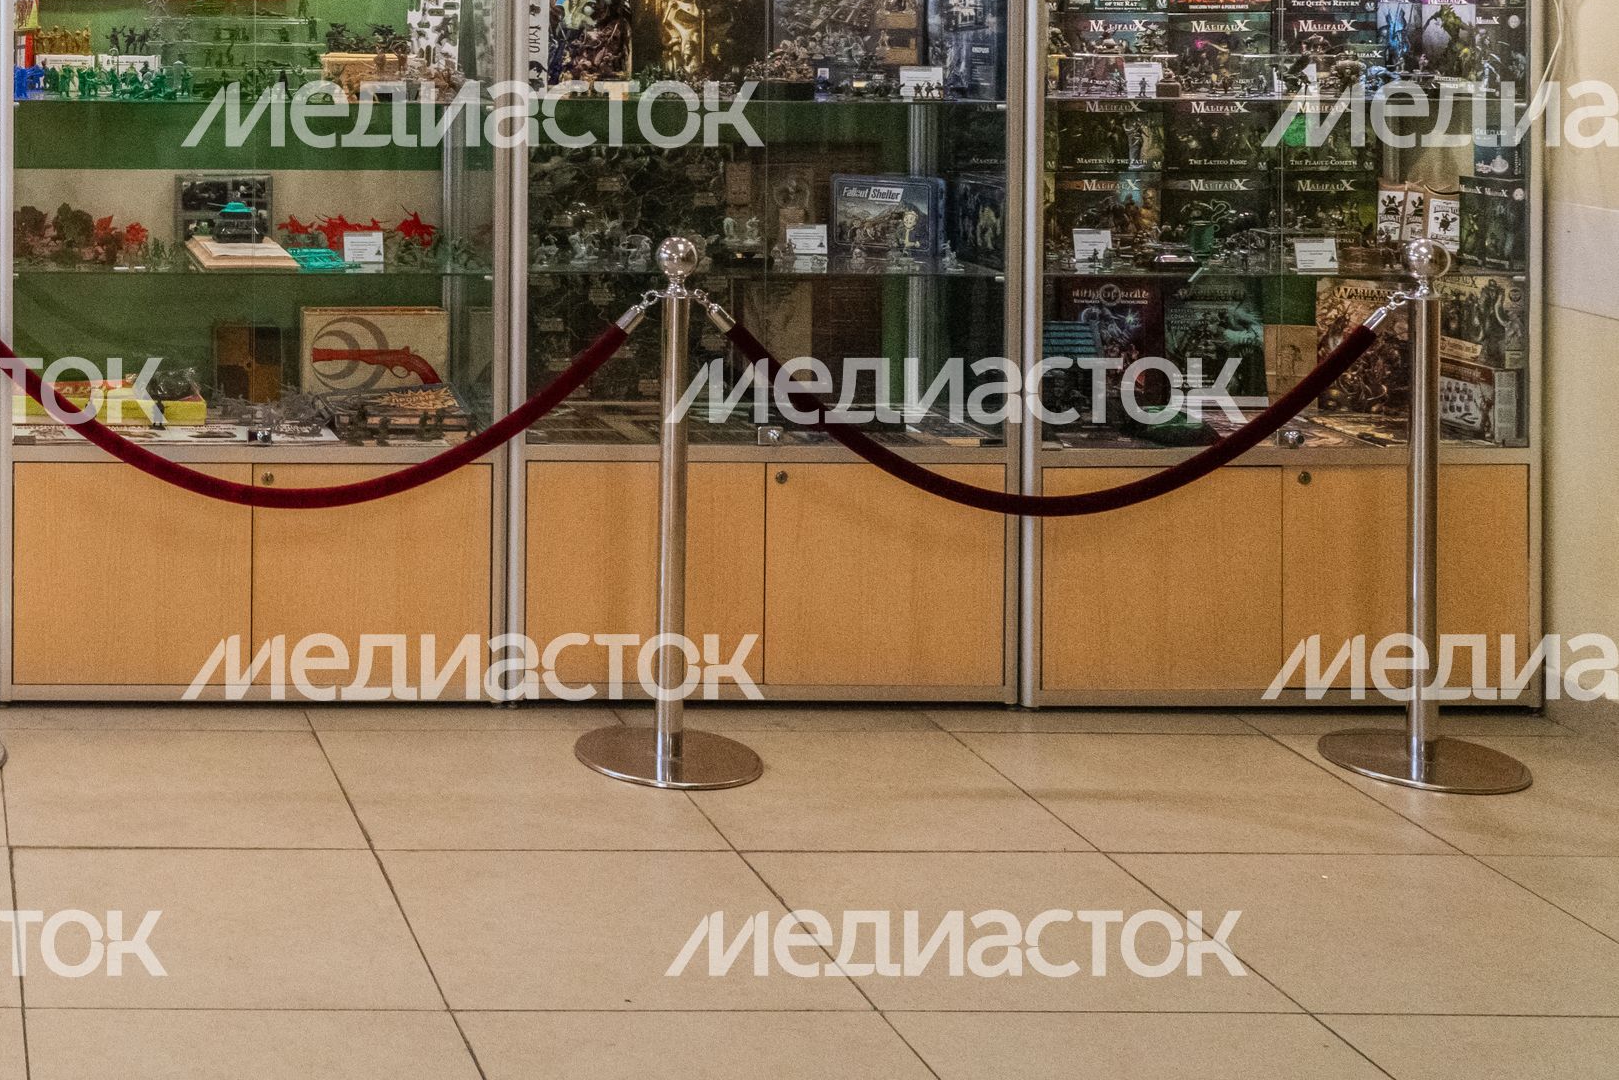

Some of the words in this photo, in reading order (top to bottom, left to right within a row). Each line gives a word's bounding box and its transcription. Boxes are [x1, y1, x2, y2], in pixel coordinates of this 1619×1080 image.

[1090, 19, 1148, 31] MLIFAUX
[1191, 20, 1253, 32] MALIFAUX
[1298, 20, 1360, 32] MALIFAUX
[1191, 101, 1251, 113] MALIFAUX
[1190, 179, 1253, 191] MALIFAUX
[1297, 179, 1357, 192] MALIFAUX
[843, 186, 868, 198] Fallout
[871, 188, 901, 200] Shelter
